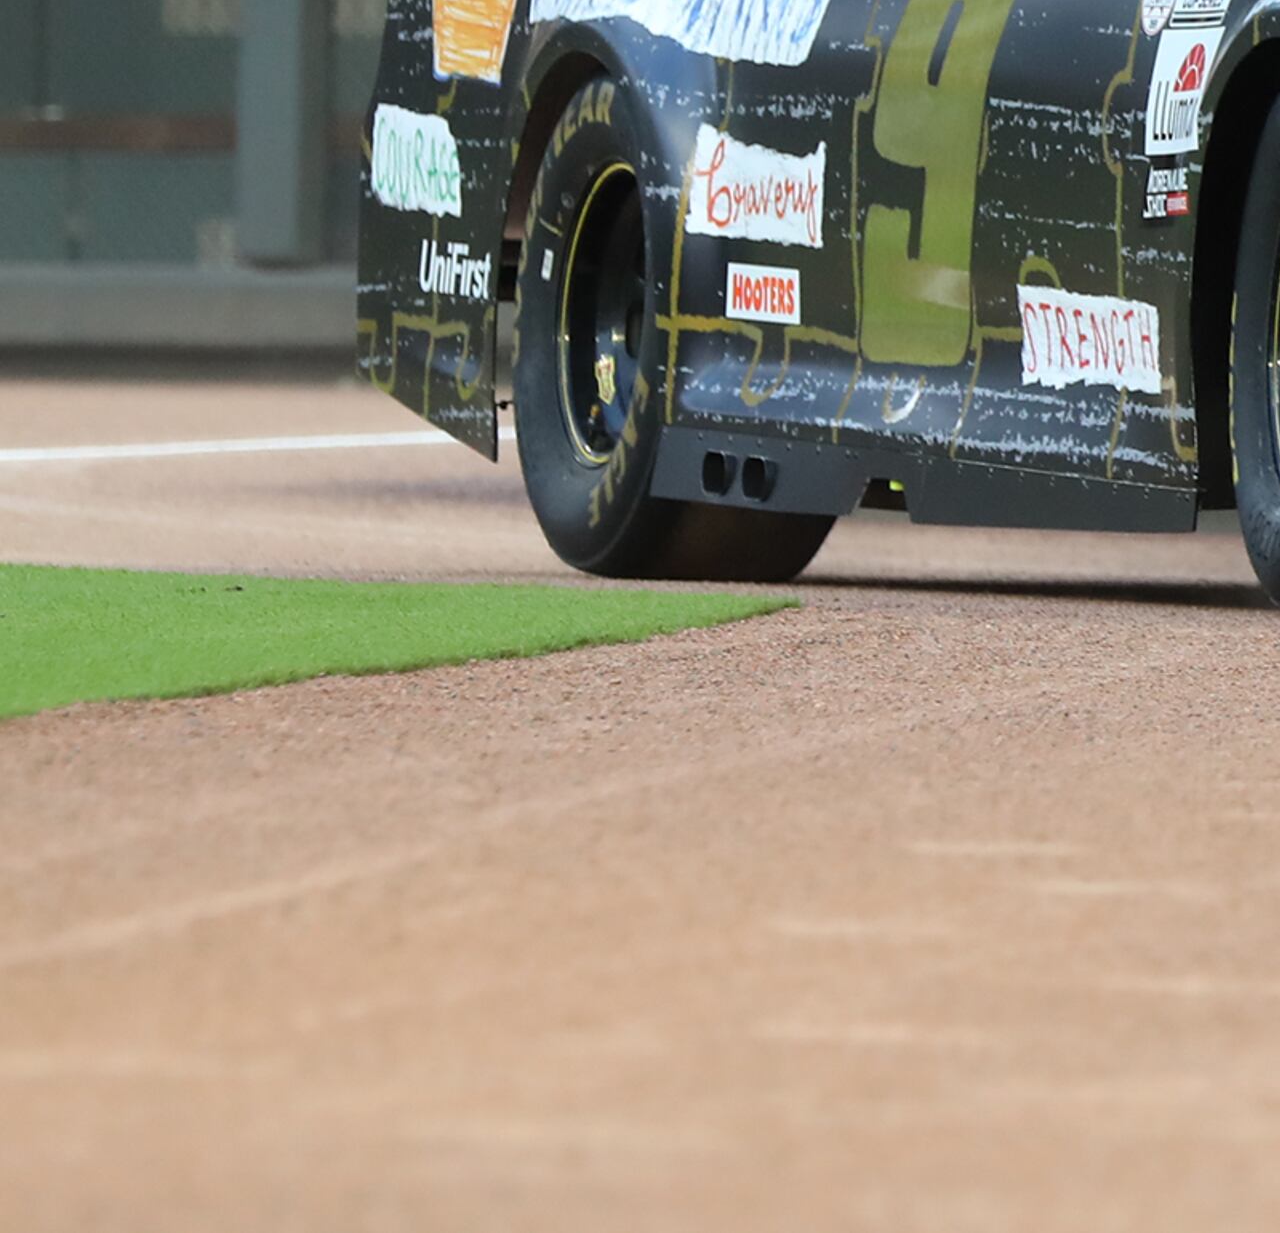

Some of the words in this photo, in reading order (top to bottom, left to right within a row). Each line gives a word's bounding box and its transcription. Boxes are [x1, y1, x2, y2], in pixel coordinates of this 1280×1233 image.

[376, 117, 458, 202] COURAGE
[694, 138, 818, 243] bravery
[419, 238, 491, 300] UniFirst
[731, 273, 796, 315] HOOTERS
[1023, 301, 1156, 375] STRENGTH
